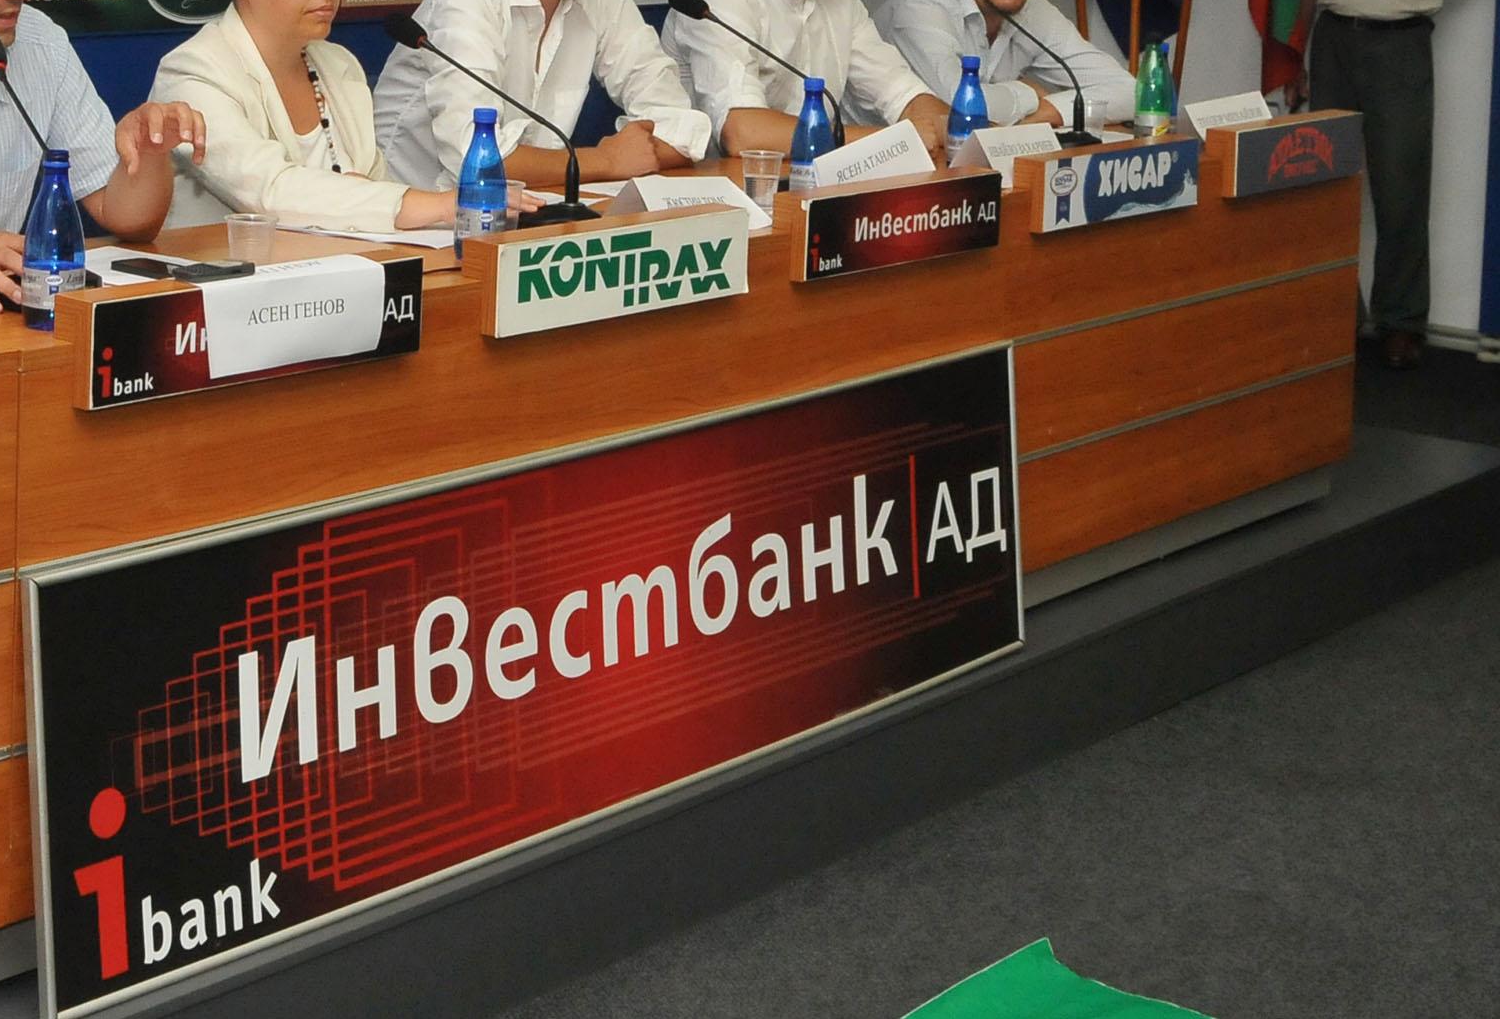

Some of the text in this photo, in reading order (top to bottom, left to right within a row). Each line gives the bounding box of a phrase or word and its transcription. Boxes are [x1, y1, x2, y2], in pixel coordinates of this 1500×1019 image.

[836, 163, 862, 184] ЯСЕН
[863, 139, 910, 175] АТАНАСОВ
[1097, 150, 1172, 198] ХИСАР
[854, 198, 996, 243] Инвестбанк АД
[517, 230, 733, 308] KONTRAX
[819, 253, 843, 271] bank
[247, 298, 346, 327] АСЕН ГЕНОВ
[383, 294, 415, 323] АД
[113, 371, 155, 397] bank
[236, 466, 1007, 783] Инвестбанк АД
[140, 858, 282, 966] bank
